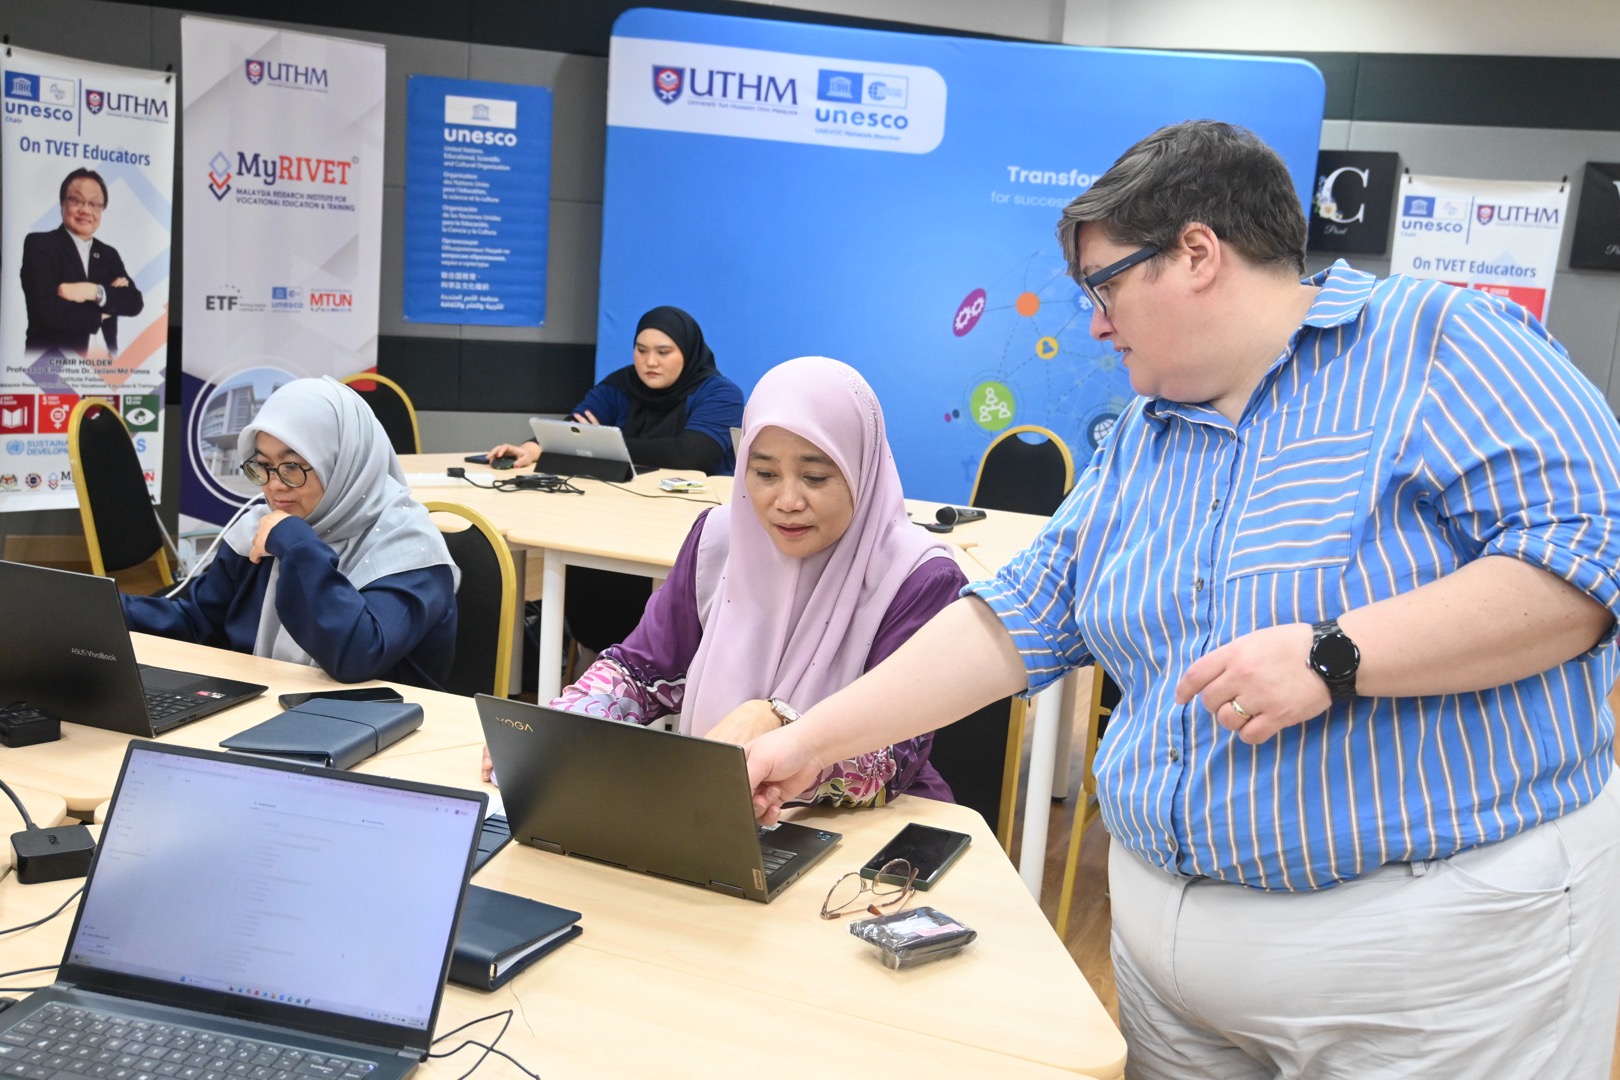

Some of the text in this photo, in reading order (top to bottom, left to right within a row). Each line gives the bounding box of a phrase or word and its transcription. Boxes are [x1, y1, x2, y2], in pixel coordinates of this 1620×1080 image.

[267, 61, 329, 87] UTHM
[689, 68, 798, 105] UTHM
[5, 102, 73, 122] unesco
[107, 92, 168, 118] UTHM
[815, 108, 908, 130] unesco
[444, 128, 517, 147] unesco
[19, 136, 151, 166] On TVET Educators
[1007, 166, 1100, 187] Transfor
[236, 188, 346, 203] MALAYSIA RESEARCH INSTITUTE FOR
[990, 191, 1010, 204] for
[1322, 167, 1369, 224] C
[236, 196, 280, 207] VOCATIONAL
[282, 199, 319, 209] EDUCATION
[326, 203, 355, 212] TRAINING
[1497, 205, 1559, 224] UTHM
[1402, 219, 1462, 233] unesco
[1412, 256, 1537, 278] On TVET Educators
[206, 295, 238, 311] ETF
[271, 301, 303, 309] unesco
[310, 293, 352, 307] MTUN
[79, 359, 112, 367] HOLDER
[26, 439, 69, 447] SUSTAIN
[26, 447, 69, 455] DEVELOP
[71, 647, 117, 661] ASUS VivoBook
[495, 716, 533, 732] YOGA
